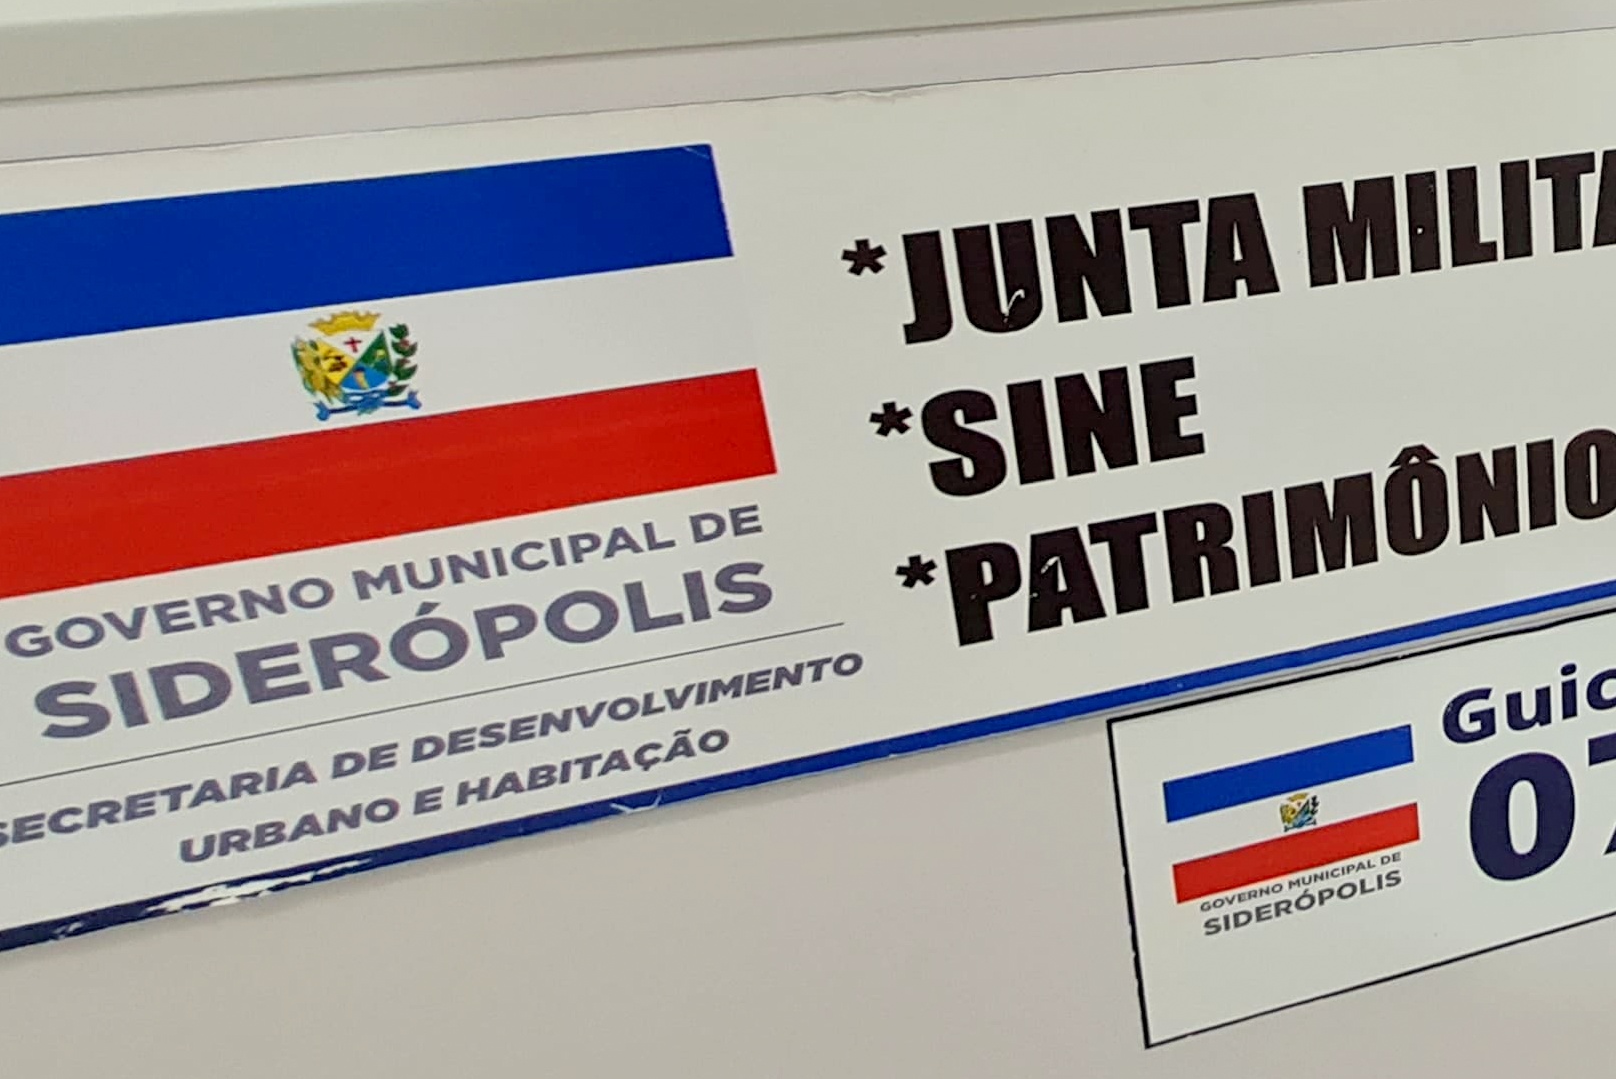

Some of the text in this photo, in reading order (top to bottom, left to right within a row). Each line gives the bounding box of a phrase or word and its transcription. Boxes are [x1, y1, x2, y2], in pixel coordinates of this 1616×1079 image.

[4, 504, 763, 658] GOVERNO MUNICIPAL DE
[33, 561, 773, 739] SIDERÓPOLIS
[331, 742, 399, 779] DE
[411, 652, 864, 763] DESENVOLVIMENTO
[180, 728, 730, 864] URBANO E HABITAÇÃO
[1200, 851, 1402, 913] GOVERNO MUNICIPAL DE
[1203, 869, 1402, 936] SIDERÓPOLIS
